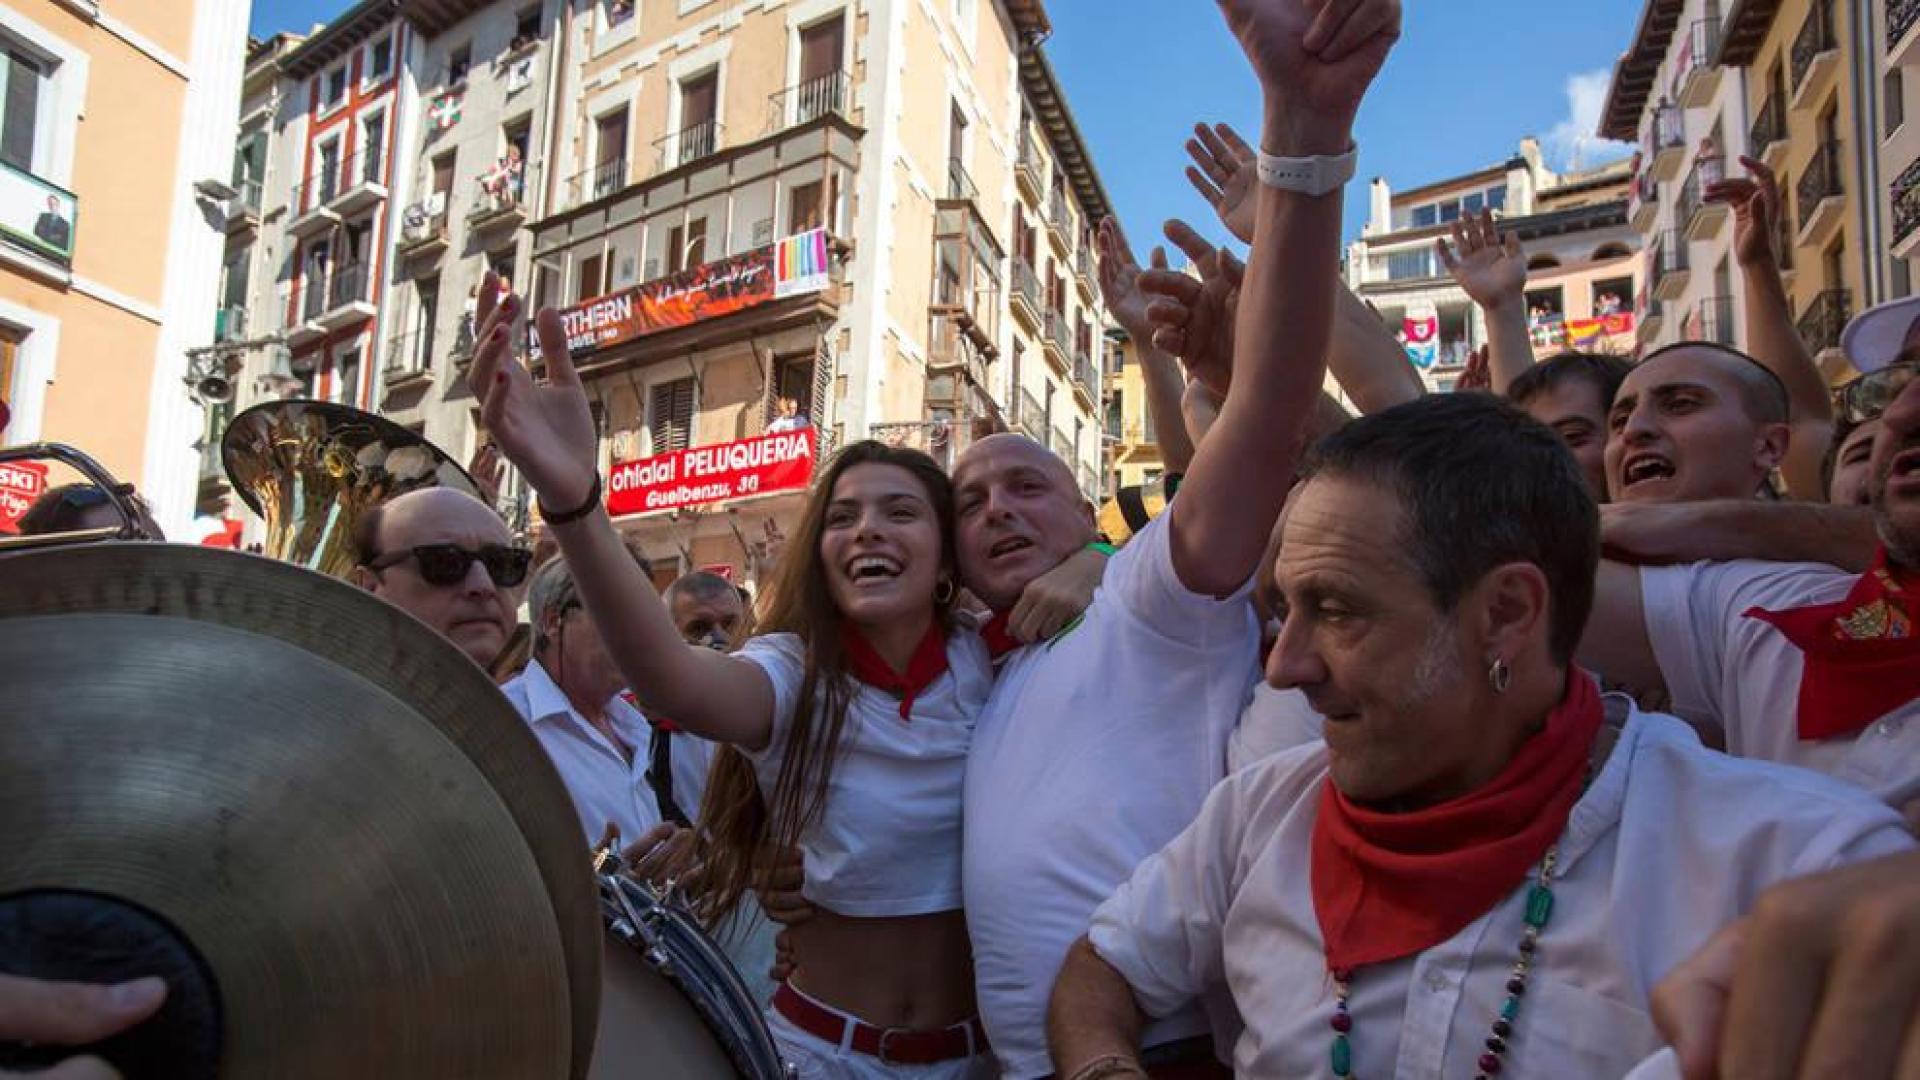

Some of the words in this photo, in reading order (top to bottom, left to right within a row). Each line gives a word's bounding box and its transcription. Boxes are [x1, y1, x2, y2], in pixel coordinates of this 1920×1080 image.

[528, 294, 632, 348] NRTHERN
[612, 455, 676, 491] ohlala!
[684, 433, 811, 478] PELUQUERIA
